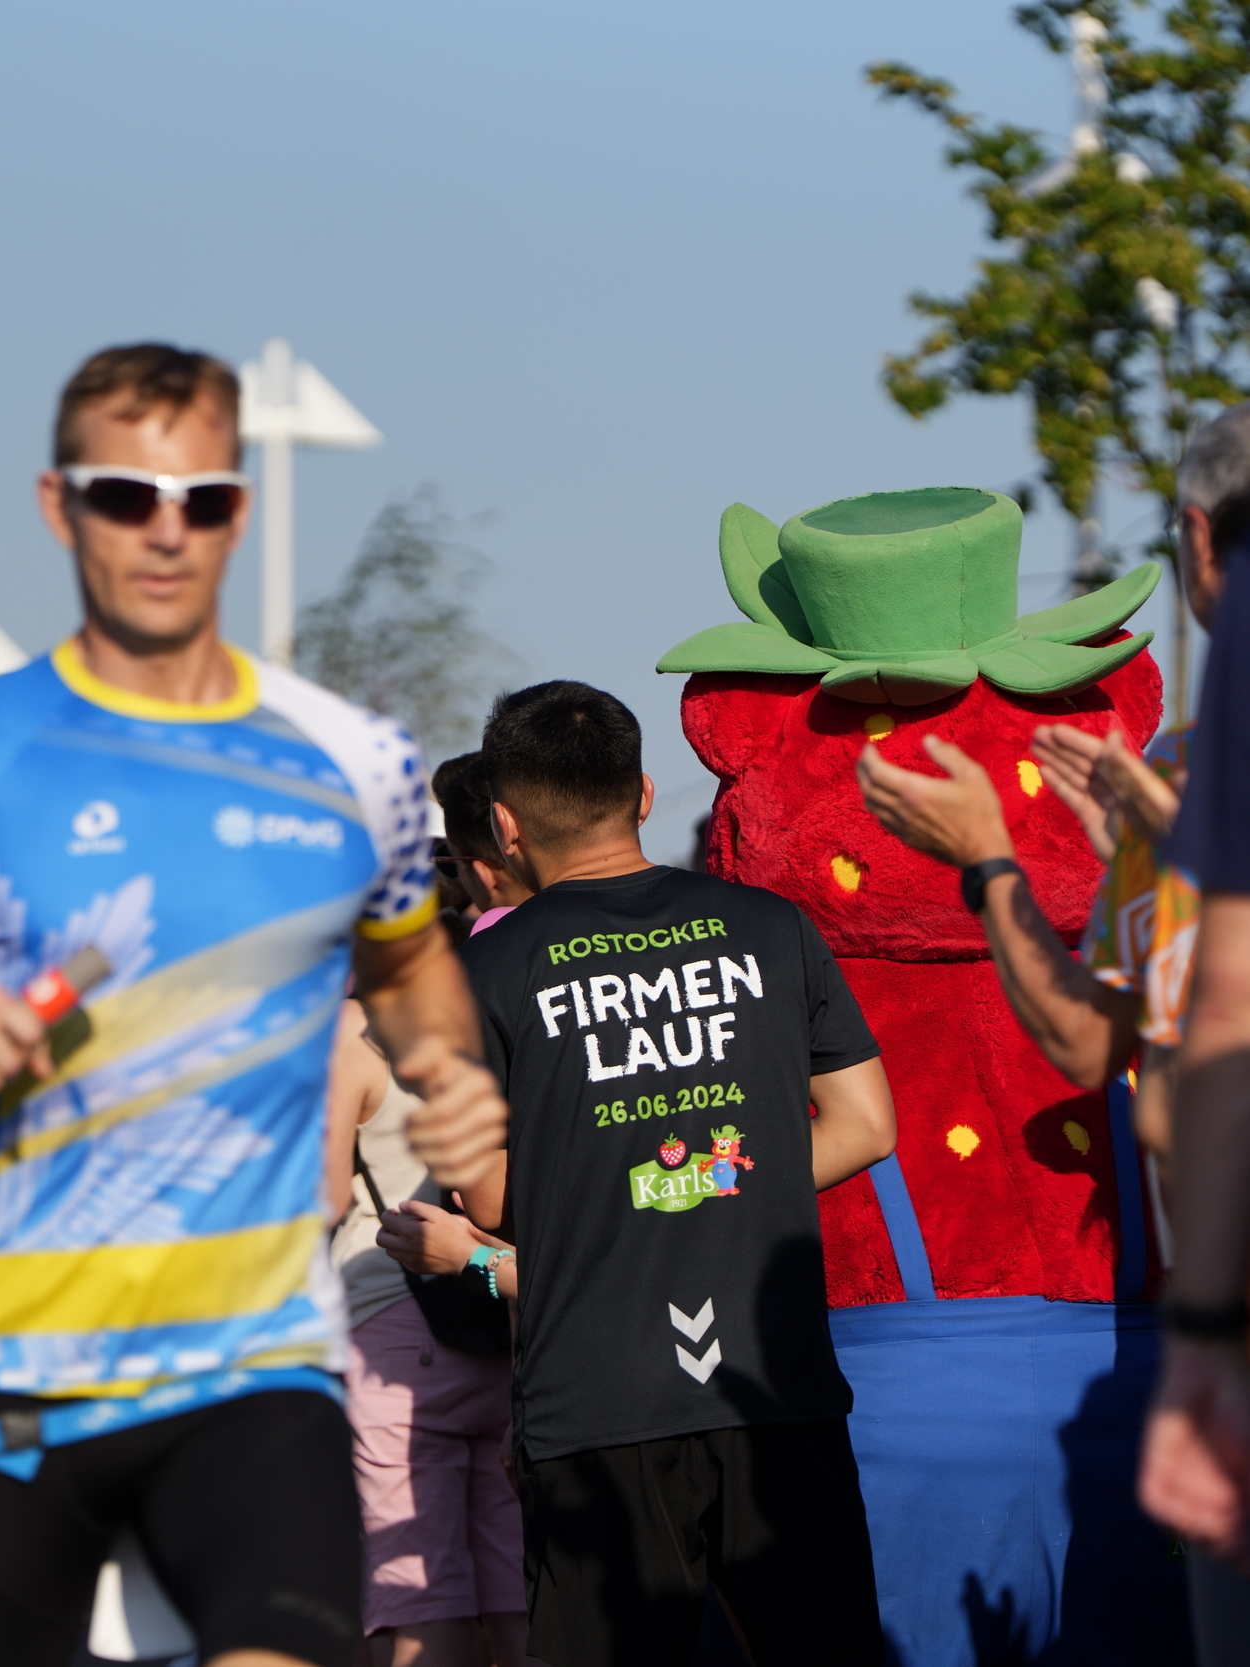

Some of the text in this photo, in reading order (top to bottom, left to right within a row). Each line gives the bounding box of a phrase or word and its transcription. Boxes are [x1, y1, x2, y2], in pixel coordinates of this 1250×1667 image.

[548, 918, 728, 965] ROSTOCKER
[536, 954, 764, 1038] FIRMEN
[584, 1011, 736, 1082] LAUF
[594, 1081, 746, 1128] 26.06.2024
[634, 1163, 716, 1204] Karls
[671, 1198, 688, 1208] 1921
